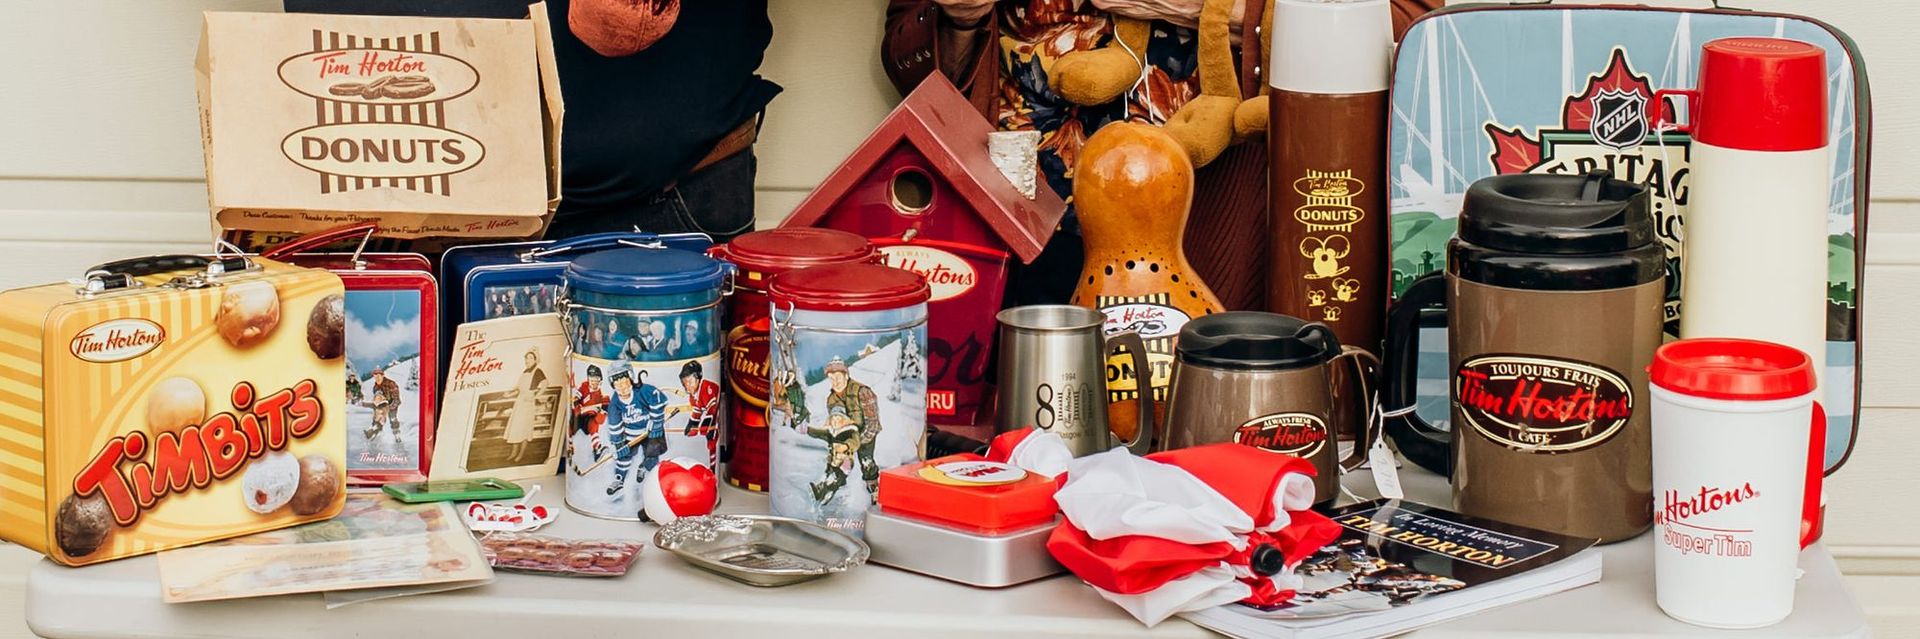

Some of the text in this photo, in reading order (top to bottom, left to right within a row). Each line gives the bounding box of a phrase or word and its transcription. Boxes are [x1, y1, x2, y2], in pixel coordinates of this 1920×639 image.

[313, 51, 426, 78] Tim Horton
[1603, 104, 1637, 138] NHL
[301, 136, 466, 165] DONUTS
[1300, 209, 1358, 221] DONUTS
[74, 328, 165, 355] Tim Hortons
[465, 330, 487, 341] The
[460, 340, 485, 363] Tim
[731, 345, 760, 377] Tim
[454, 357, 503, 380] Horton
[1490, 364, 1602, 388] TOUJOURS FRAIS
[653, 389, 661, 403] 7
[707, 385, 713, 394] 6
[1460, 369, 1630, 423] Tim Hortons
[625, 403, 642, 416] Tim
[1263, 416, 1312, 428] ALWAYS FRESH
[1239, 424, 1326, 447] Tim Hortons
[360, 452, 376, 462] Tim
[826, 517, 842, 529] Tim
[1413, 517, 1460, 536] Loving
[1462, 530, 1524, 549] Memory
[1342, 514, 1517, 566] TIM HORTON
